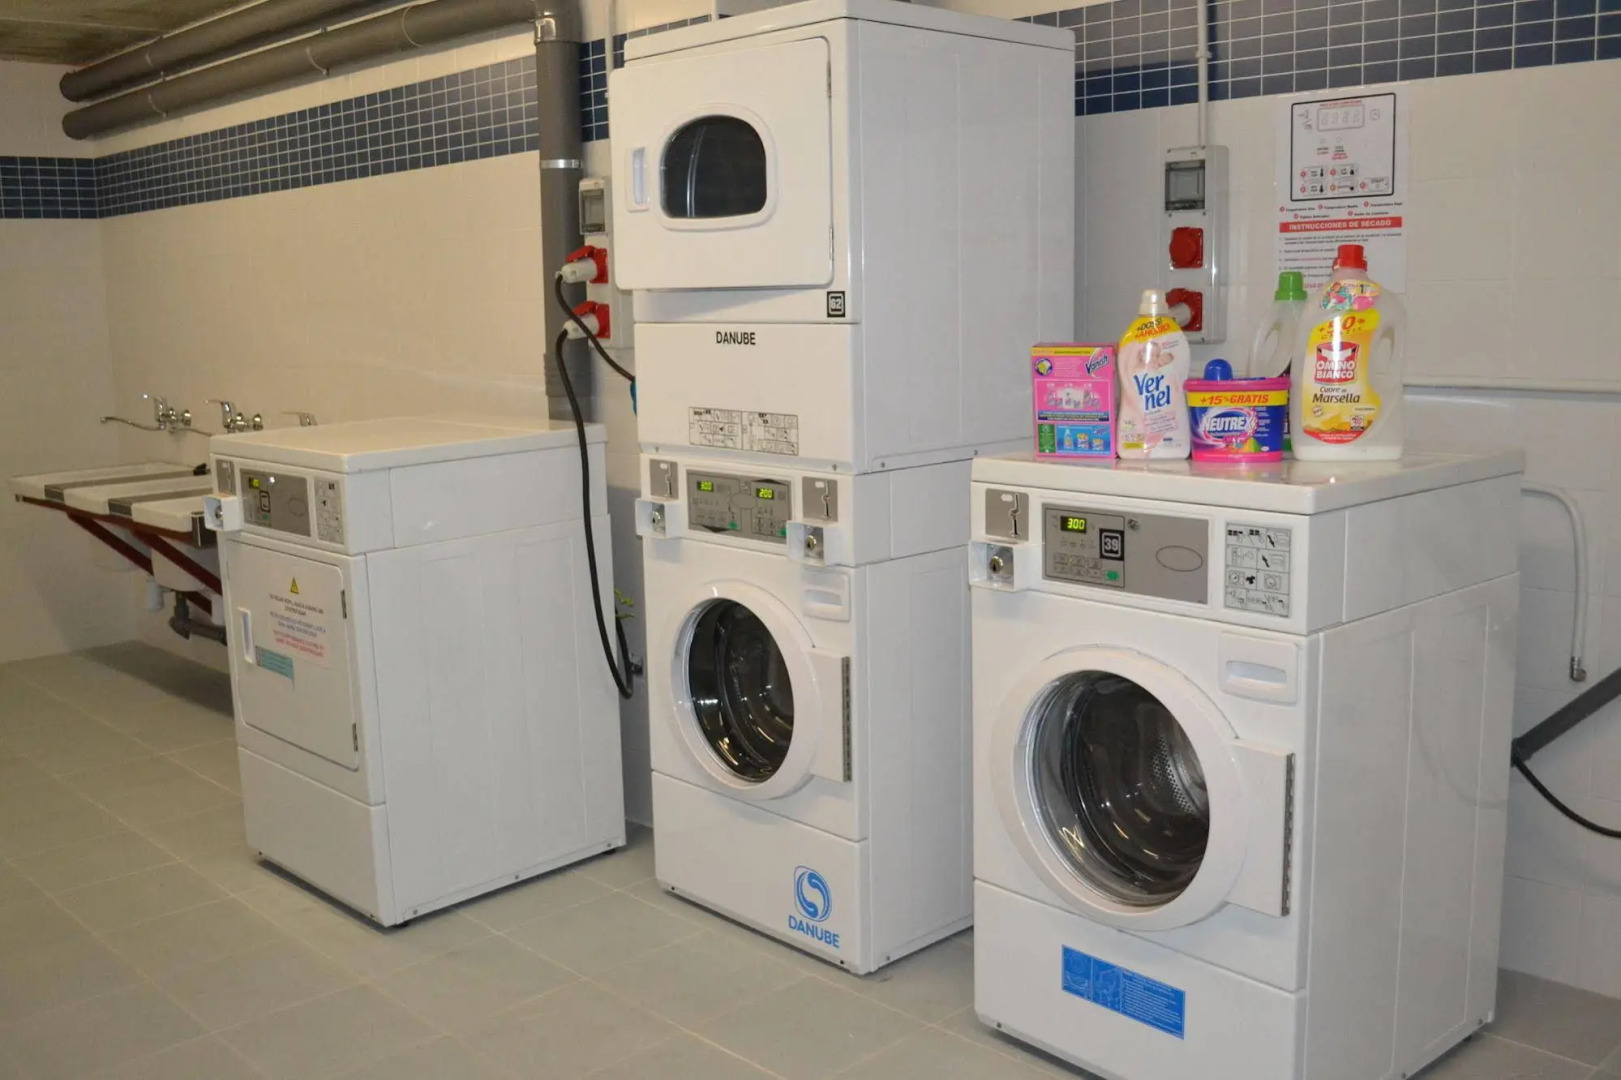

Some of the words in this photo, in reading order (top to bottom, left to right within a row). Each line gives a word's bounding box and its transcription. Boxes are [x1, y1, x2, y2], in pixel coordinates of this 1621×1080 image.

[1289, 222, 1347, 231] INSTRUCCIONES
[1361, 219, 1392, 227] SECADO
[716, 331, 756, 346] DANUBE
[1085, 355, 1109, 374] Vanish
[1316, 360, 1356, 370] OMNO
[1316, 370, 1354, 379] BIANCO
[1133, 373, 1164, 395] Ver
[1144, 385, 1171, 411] nel
[1229, 394, 1269, 404] GRATIS
[1312, 393, 1360, 403] Marsella
[1202, 416, 1252, 431] NEUTREX
[700, 481, 713, 492] 300
[759, 488, 773, 499] 200
[1067, 518, 1086, 530] 300
[1104, 538, 1119, 551] 39
[788, 914, 840, 949] DANUBE
